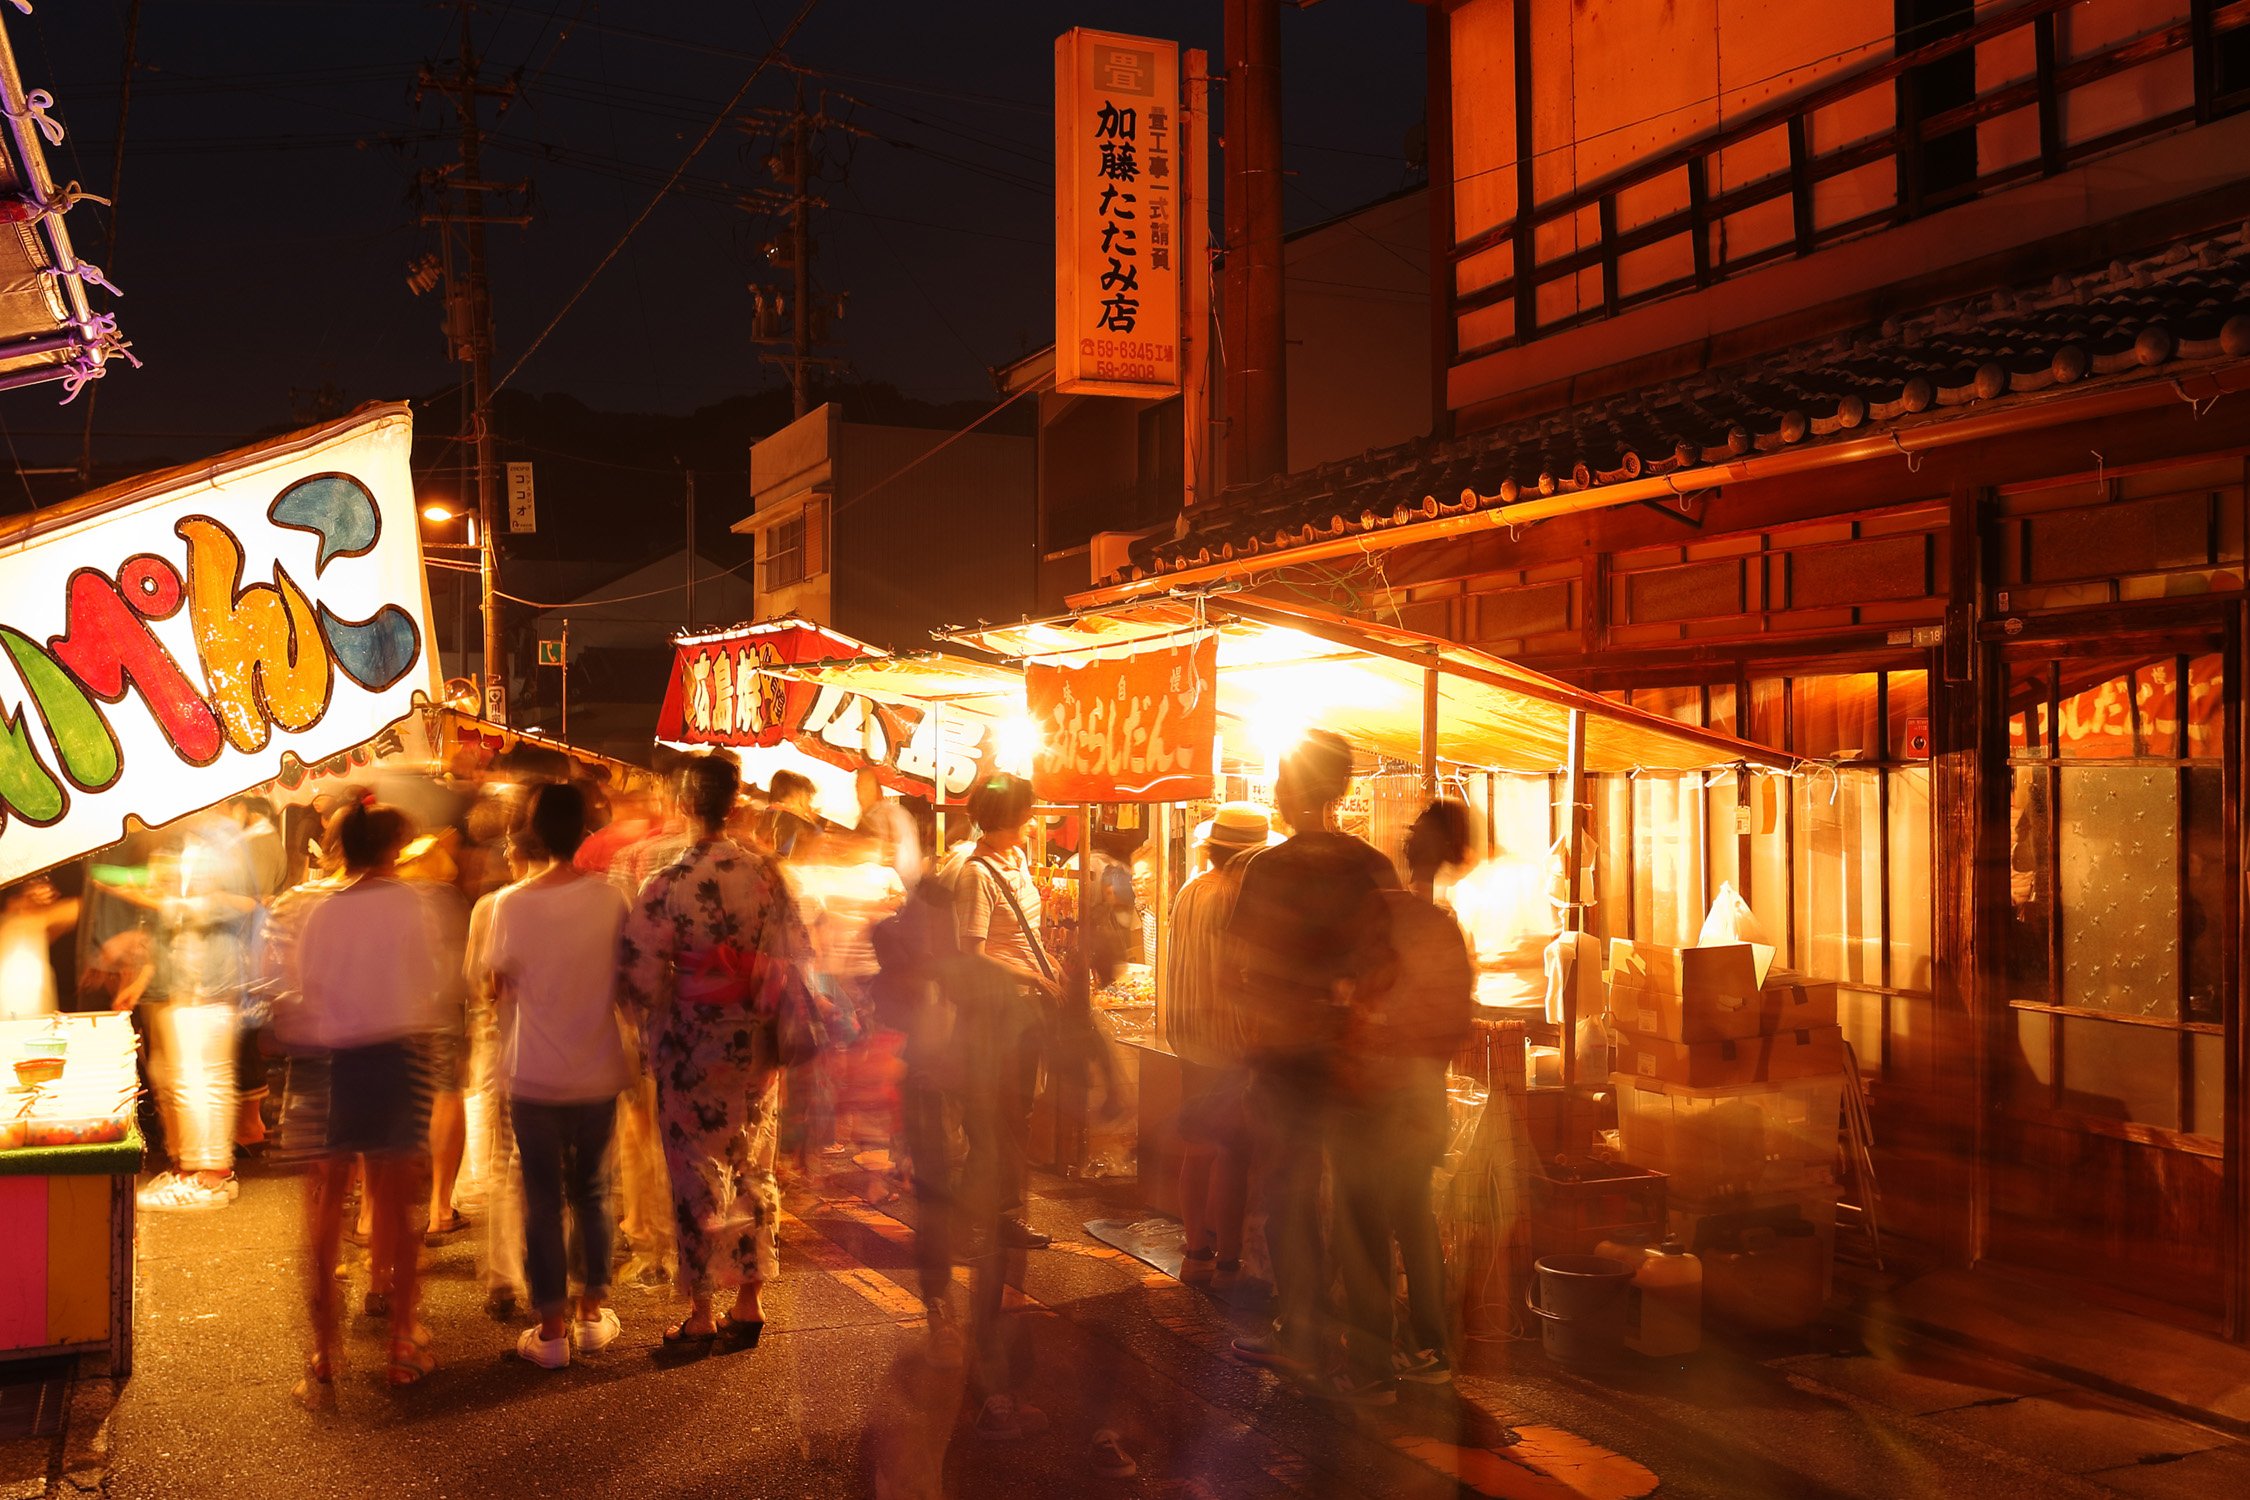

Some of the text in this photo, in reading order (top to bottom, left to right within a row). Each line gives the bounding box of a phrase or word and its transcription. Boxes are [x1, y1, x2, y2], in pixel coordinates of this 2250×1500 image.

[1094, 99, 1140, 334] 加藤たたみ店
